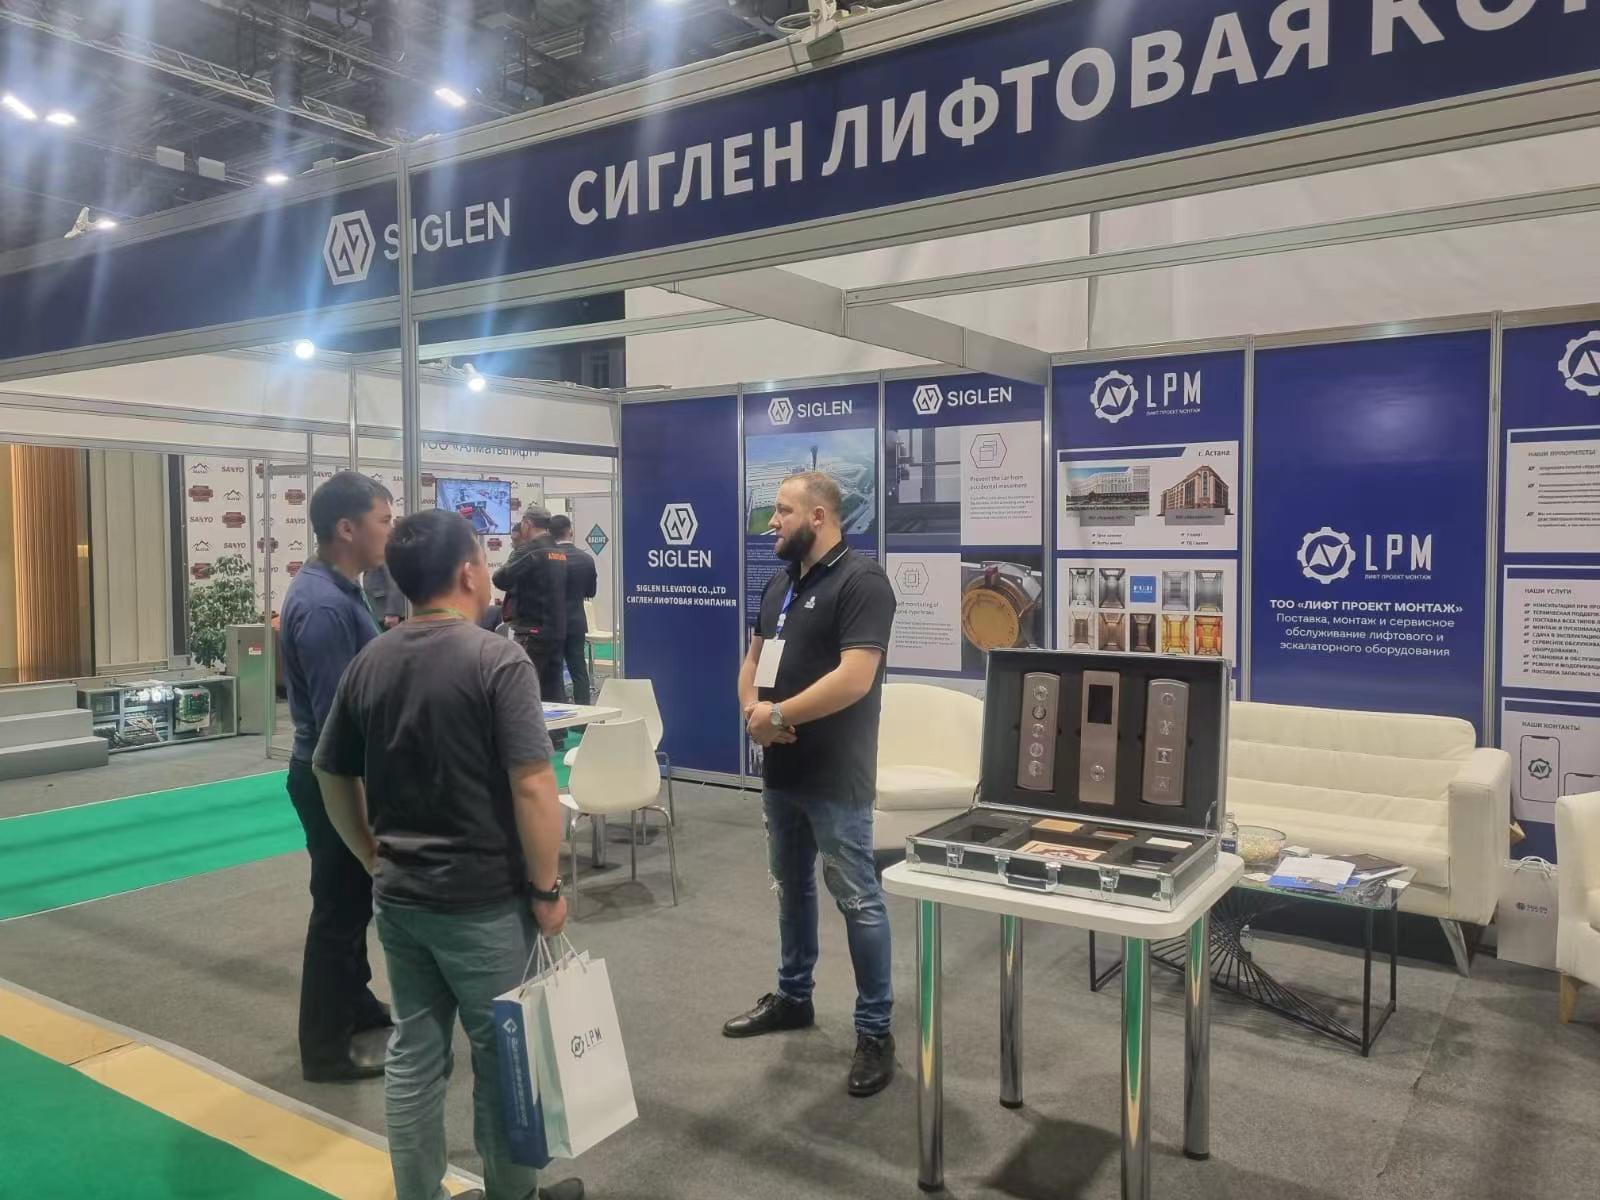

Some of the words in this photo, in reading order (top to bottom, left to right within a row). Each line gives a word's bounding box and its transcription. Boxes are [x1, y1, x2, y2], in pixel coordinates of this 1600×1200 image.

[568, 119, 803, 226] СИГЛЕН
[821, 0, 1330, 177] ЛИФТОВАЯ
[383, 197, 510, 260] SIGLEN
[946, 386, 1012, 407] SIGLEN
[1146, 371, 1201, 408] LPM
[797, 400, 853, 418] SIGLEN
[1205, 449, 1231, 457] Астана
[647, 549, 712, 568] SIGLEN
[1365, 533, 1432, 571] LPM
[636, 584, 661, 592] SIGLEN
[661, 585, 697, 593] ELEVATOR
[626, 596, 654, 604] СИГЛЕН
[654, 596, 693, 605] ЛИФТОВАЯ
[693, 598, 737, 607] КОМПАНИЯ
[1269, 599, 1295, 609] ТОО
[1297, 600, 1340, 611] «ЛИФТ
[1341, 601, 1392, 612] ПРОЕКТ
[1394, 602, 1463, 613] МОНТАЖ»
[1276, 613, 1330, 625] Поставка,
[1332, 617, 1376, 625] монтаж
[1379, 618, 1387, 626] и
[1389, 618, 1455, 629] сервисное
[1285, 627, 1366, 640] обслуживание
[1369, 631, 1433, 644] лифтового
[1436, 634, 1444, 642] и
[1280, 641, 1362, 655] эскалаторного
[1365, 644, 1450, 658] оборудования
